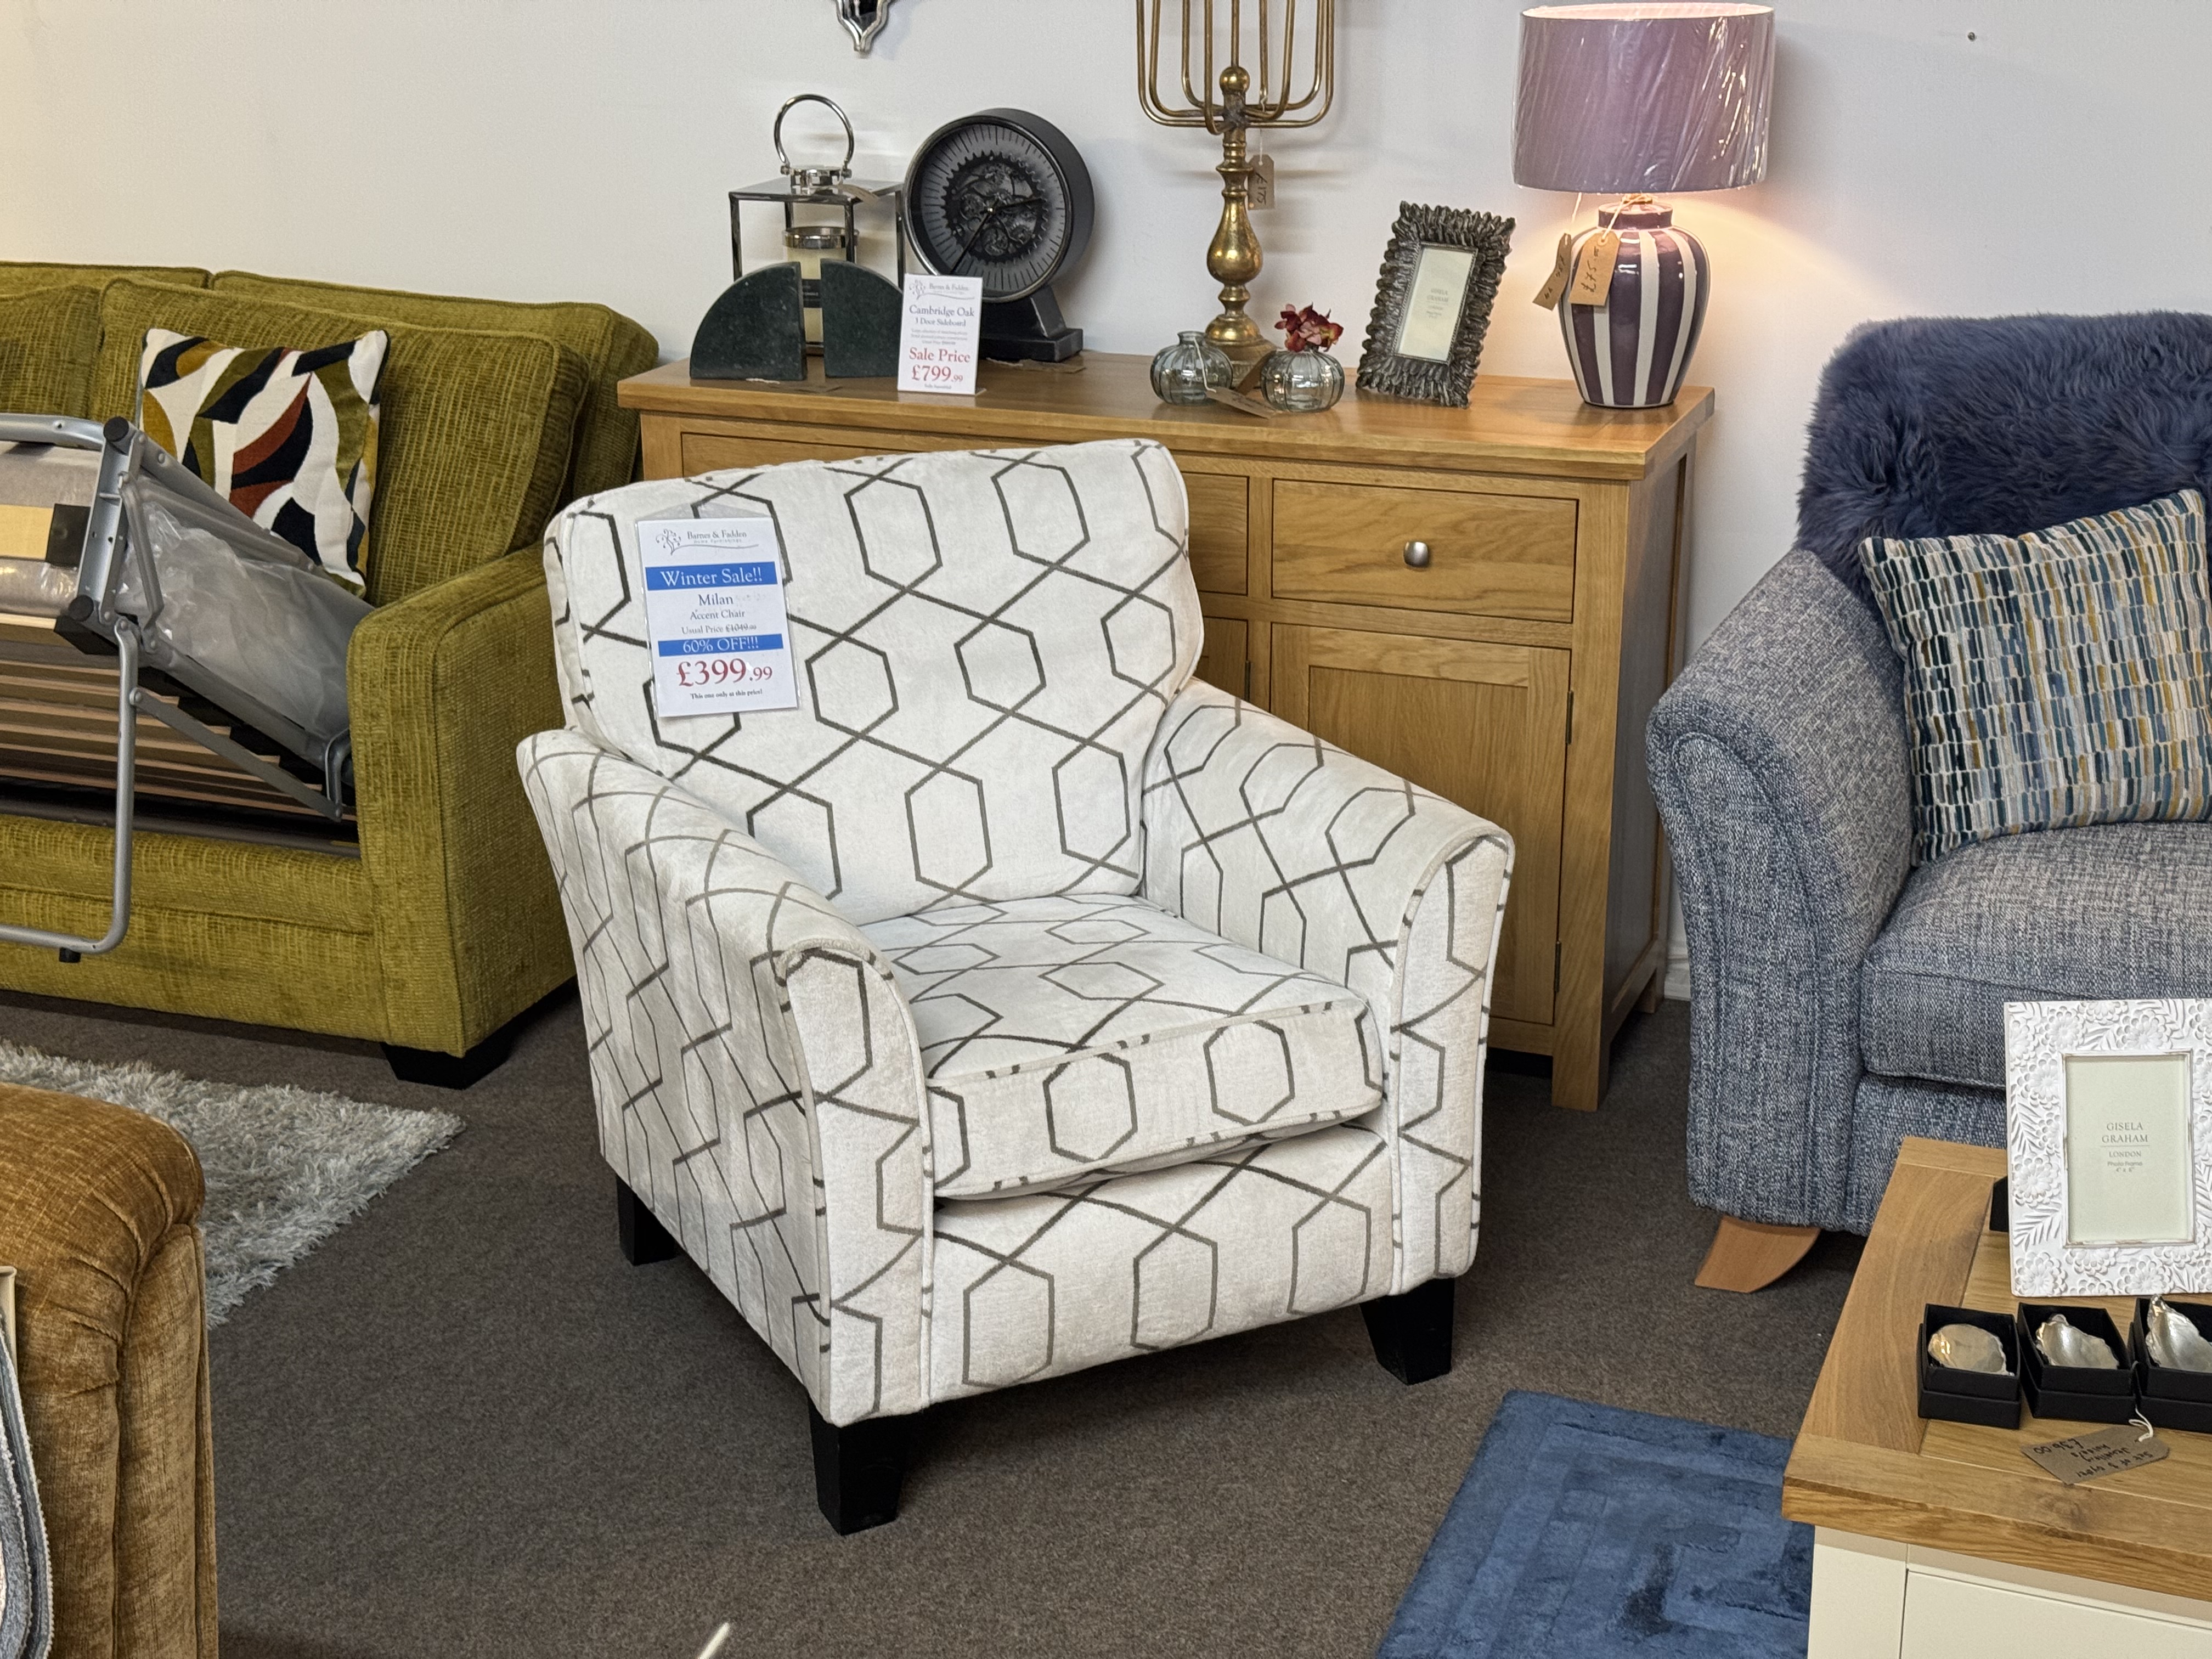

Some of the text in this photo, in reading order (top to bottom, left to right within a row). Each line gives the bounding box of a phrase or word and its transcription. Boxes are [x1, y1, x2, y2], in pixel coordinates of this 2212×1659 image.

[909, 304, 974, 317] Cambridge Oak
[936, 318, 966, 326] Sideboard
[909, 346, 971, 363] Sale Price
[911, 364, 963, 382] £799.99
[687, 529, 747, 540] Barnes & Fadden
[661, 567, 763, 586] Winter Sale!!
[698, 593, 734, 606] Milan
[690, 609, 746, 620] Accent Chair
[681, 625, 703, 635] Usual
[705, 625, 724, 634] Price
[683, 636, 759, 653] 60% OFF!!!
[676, 658, 773, 687] £399.99
[747, 688, 763, 697] price!
[2106, 1121, 2143, 1131] GISELA
[2102, 1134, 2148, 1143] GRAHAM
[2033, 1437, 2084, 1454] £36.00
[2132, 1451, 2153, 1461] Set
[2119, 1458, 2131, 1466] of
